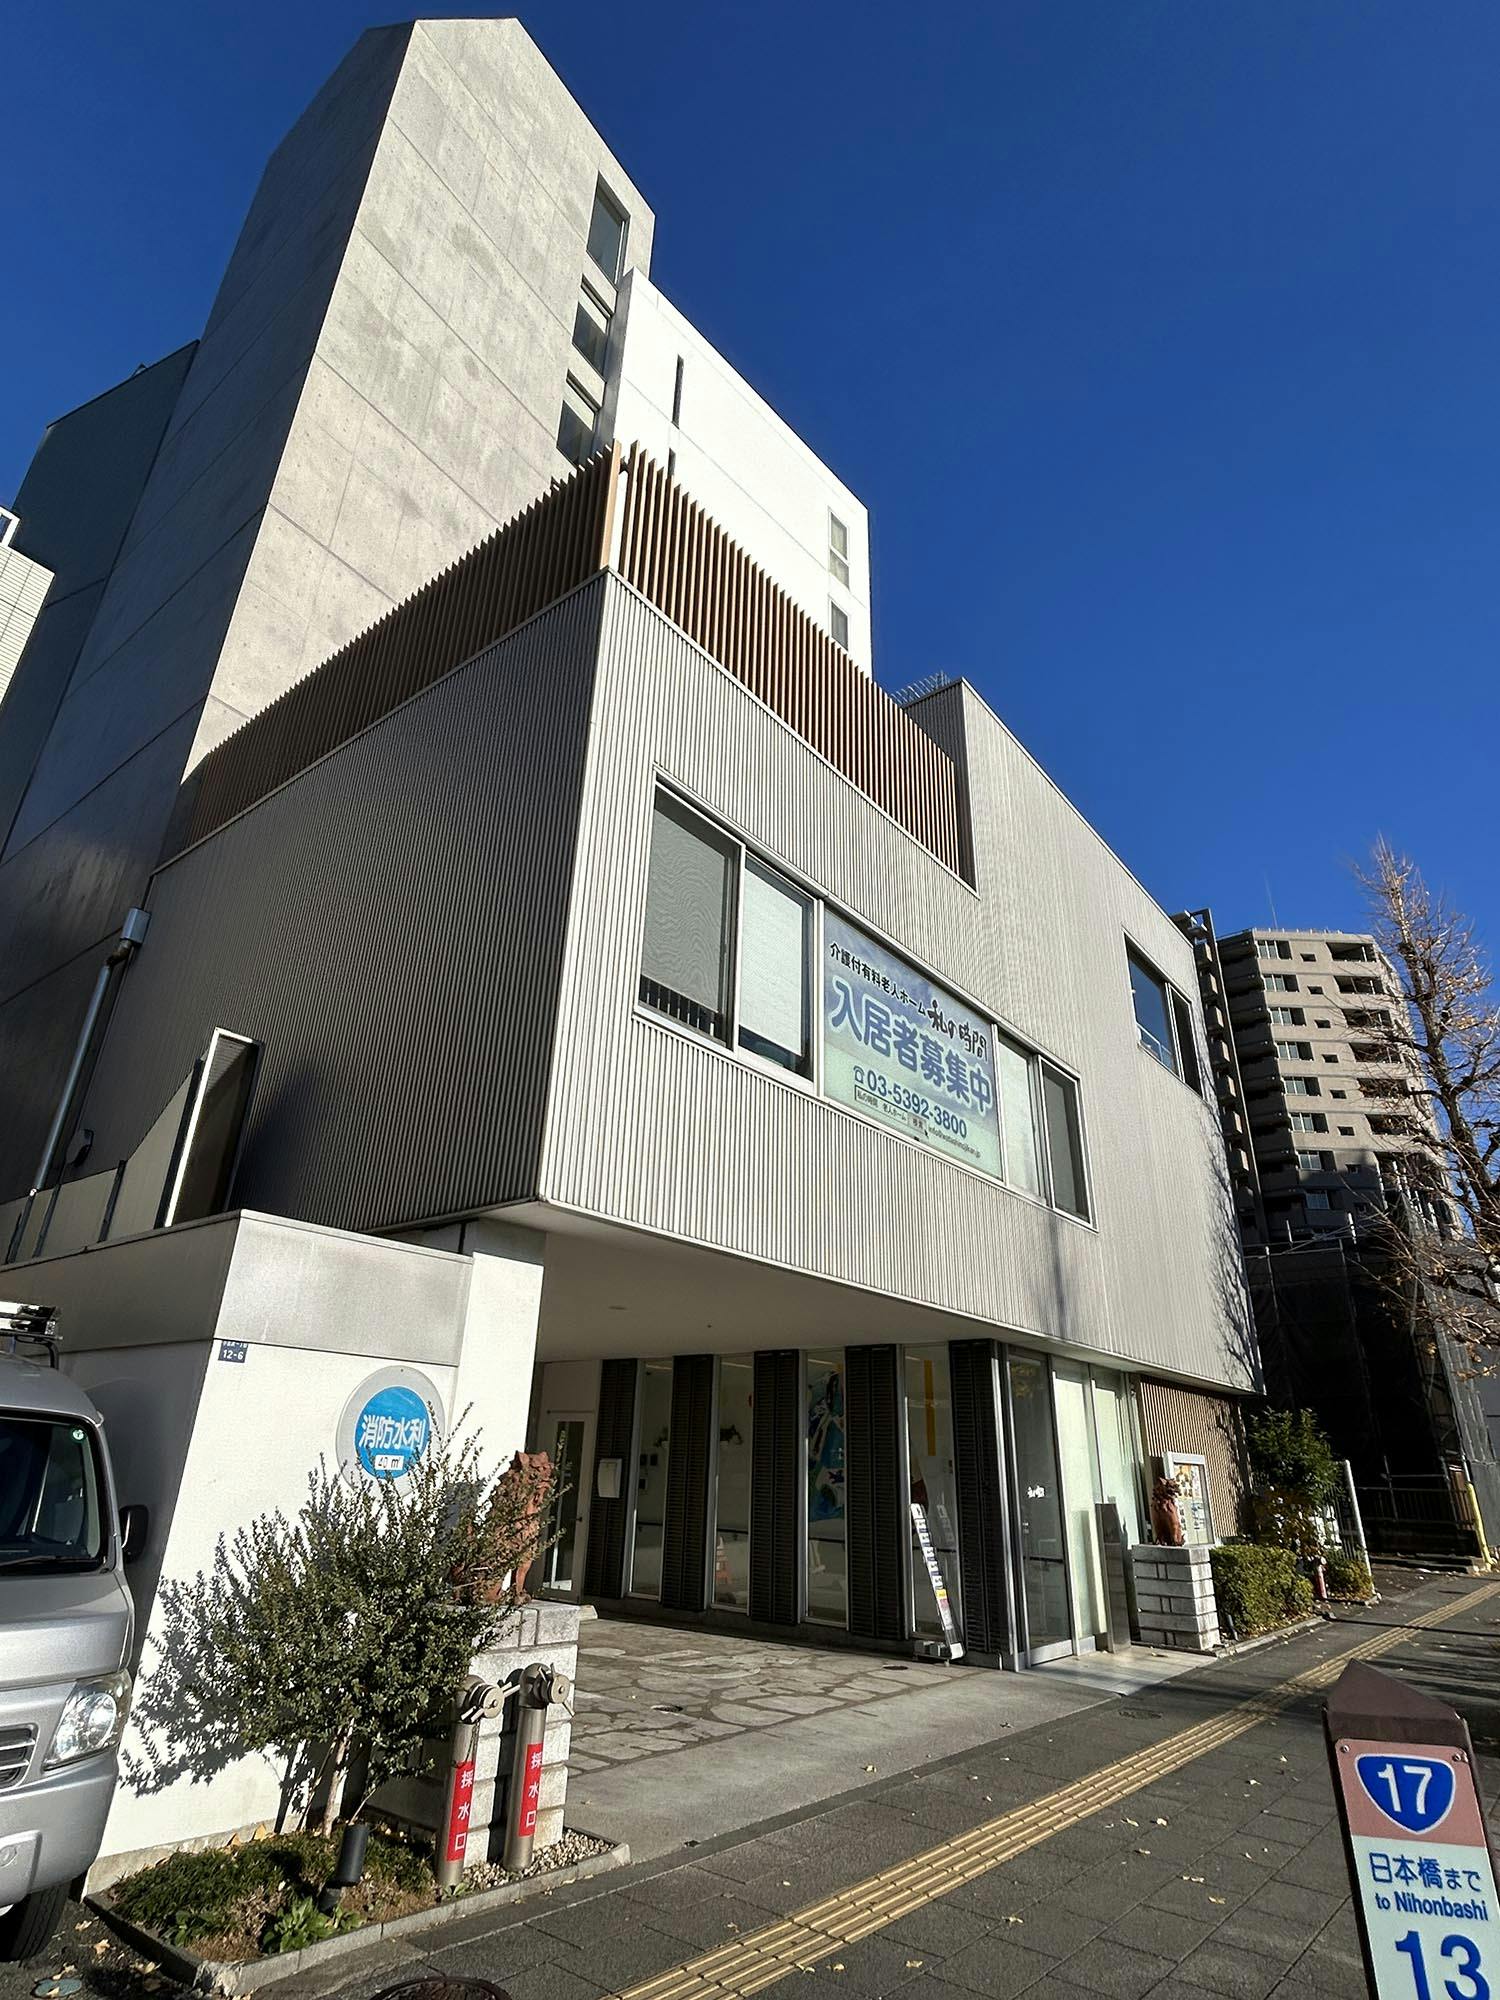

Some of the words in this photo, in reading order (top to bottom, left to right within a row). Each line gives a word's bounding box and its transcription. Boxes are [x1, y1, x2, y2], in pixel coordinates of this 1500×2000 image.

[830, 943, 926, 1015] 介護付有料老人ホーム
[830, 979, 992, 1113] 入居者募集中
[867, 1070, 967, 1139] 03-5392-3800
[223, 1349, 244, 1360] 12-6
[359, 1414, 426, 1450] 消防水利
[1377, 1763, 1433, 1815] 17
[1369, 1852, 1482, 1893] 日本橋まで
[1375, 1893, 1391, 1911] to
[1394, 1890, 1489, 1922] Nihonbashi
[1394, 1930, 1490, 2000] 13
